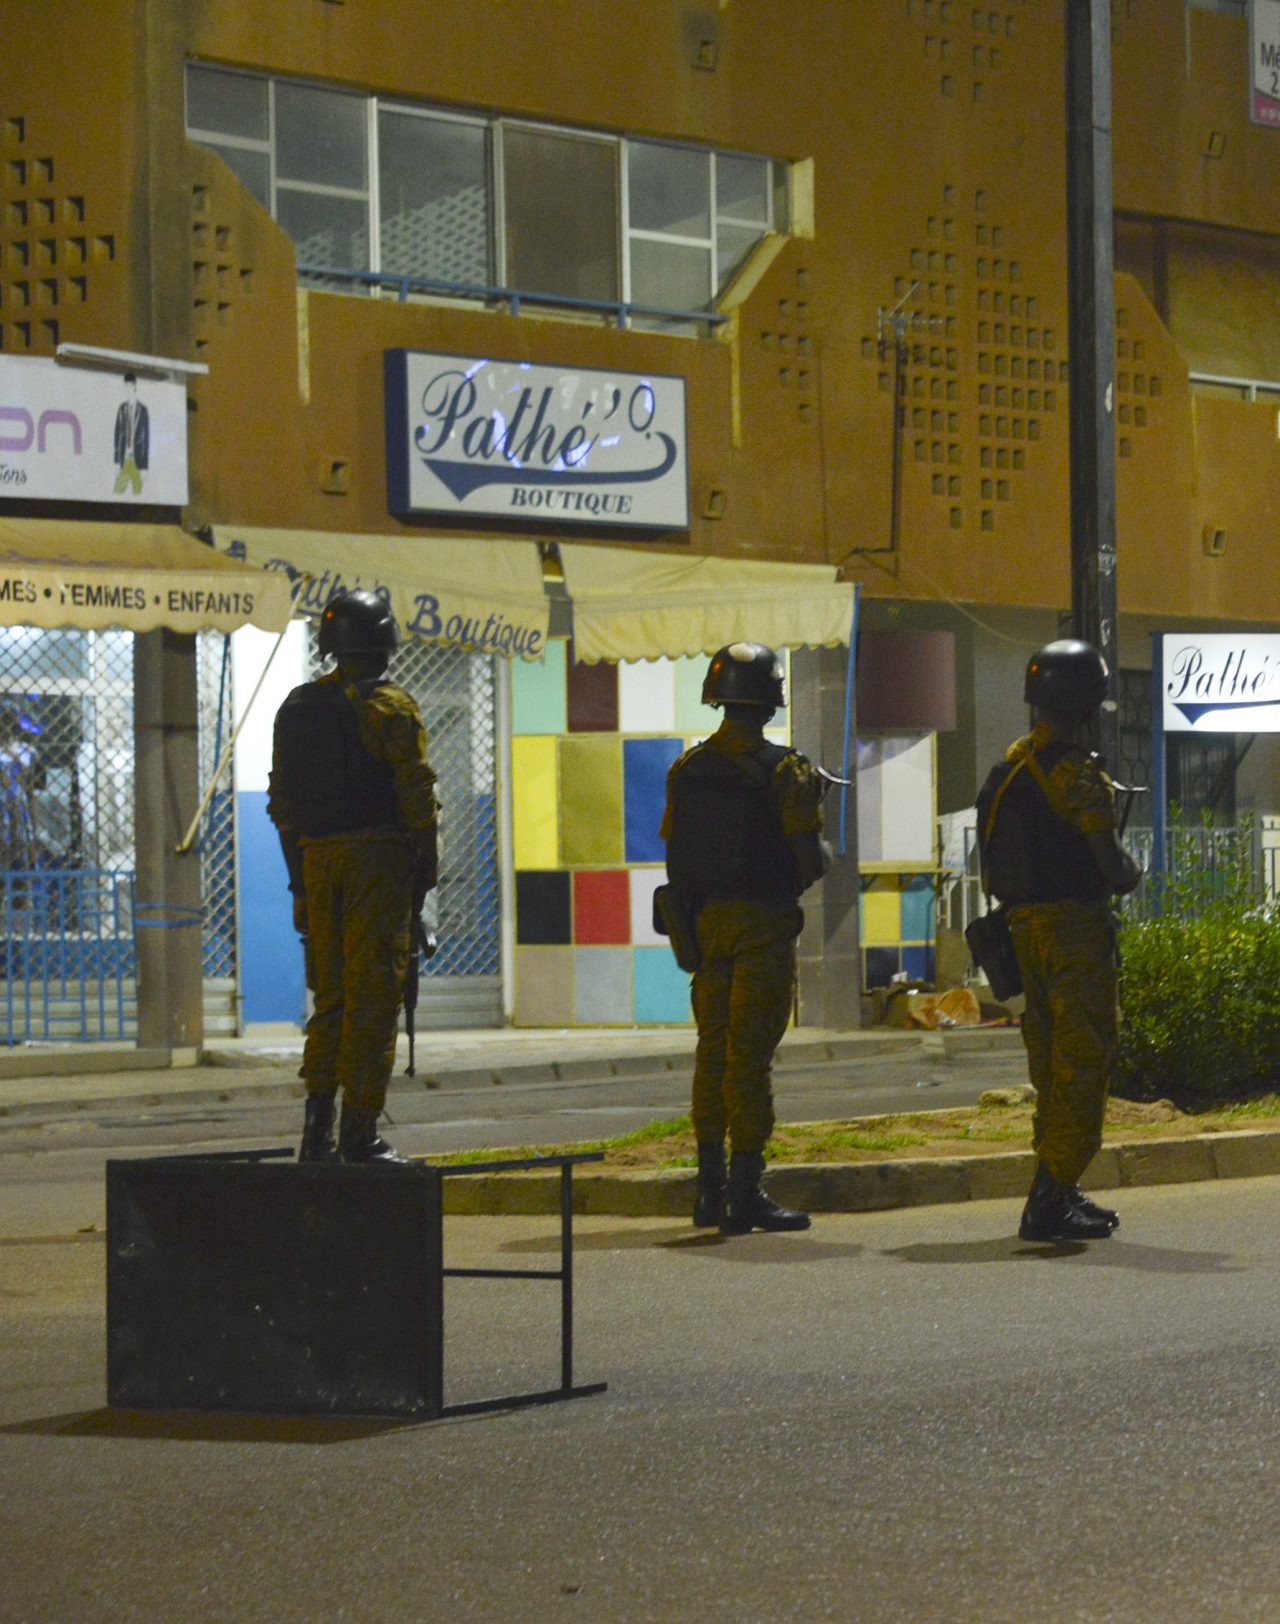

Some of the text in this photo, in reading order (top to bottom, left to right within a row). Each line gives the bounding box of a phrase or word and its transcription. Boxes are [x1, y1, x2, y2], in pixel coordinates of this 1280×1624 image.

[510, 487, 633, 514] BOUTIQUE
[168, 590, 254, 615] ENFANTS
[406, 592, 542, 655] Boutique
